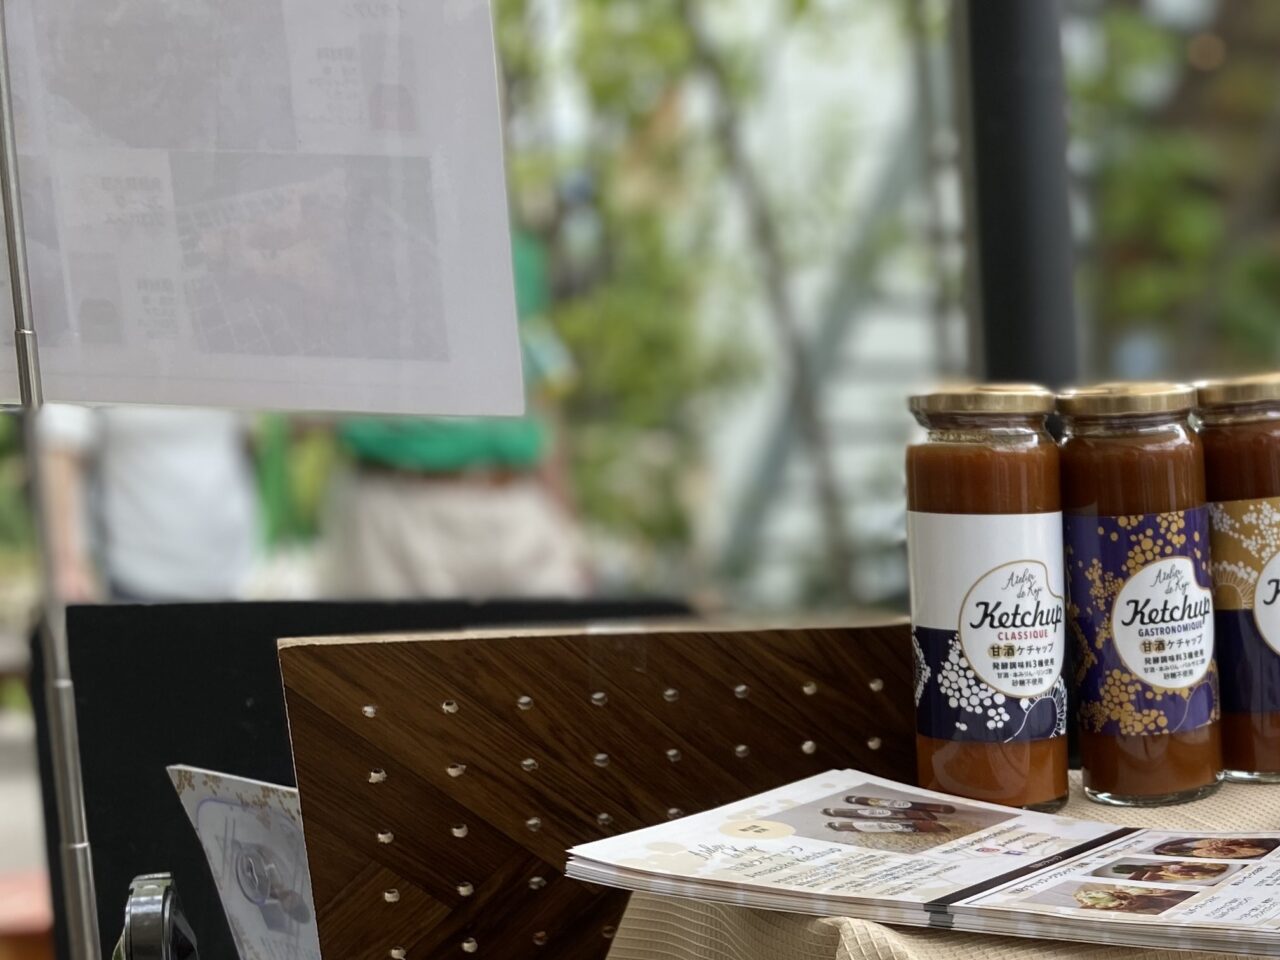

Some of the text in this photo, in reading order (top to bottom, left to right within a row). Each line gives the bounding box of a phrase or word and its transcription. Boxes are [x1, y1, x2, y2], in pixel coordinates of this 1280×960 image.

[969, 601, 1063, 633] Ketchup
[1121, 595, 1210, 627] Ketchup
[998, 629, 1048, 640] CLASSIQUE
[1138, 620, 1203, 637] GASTRONOMIQUE
[990, 642, 1054, 657] 甘酒ケチャップ
[1142, 634, 1203, 653] 甘酒ケチャップ
